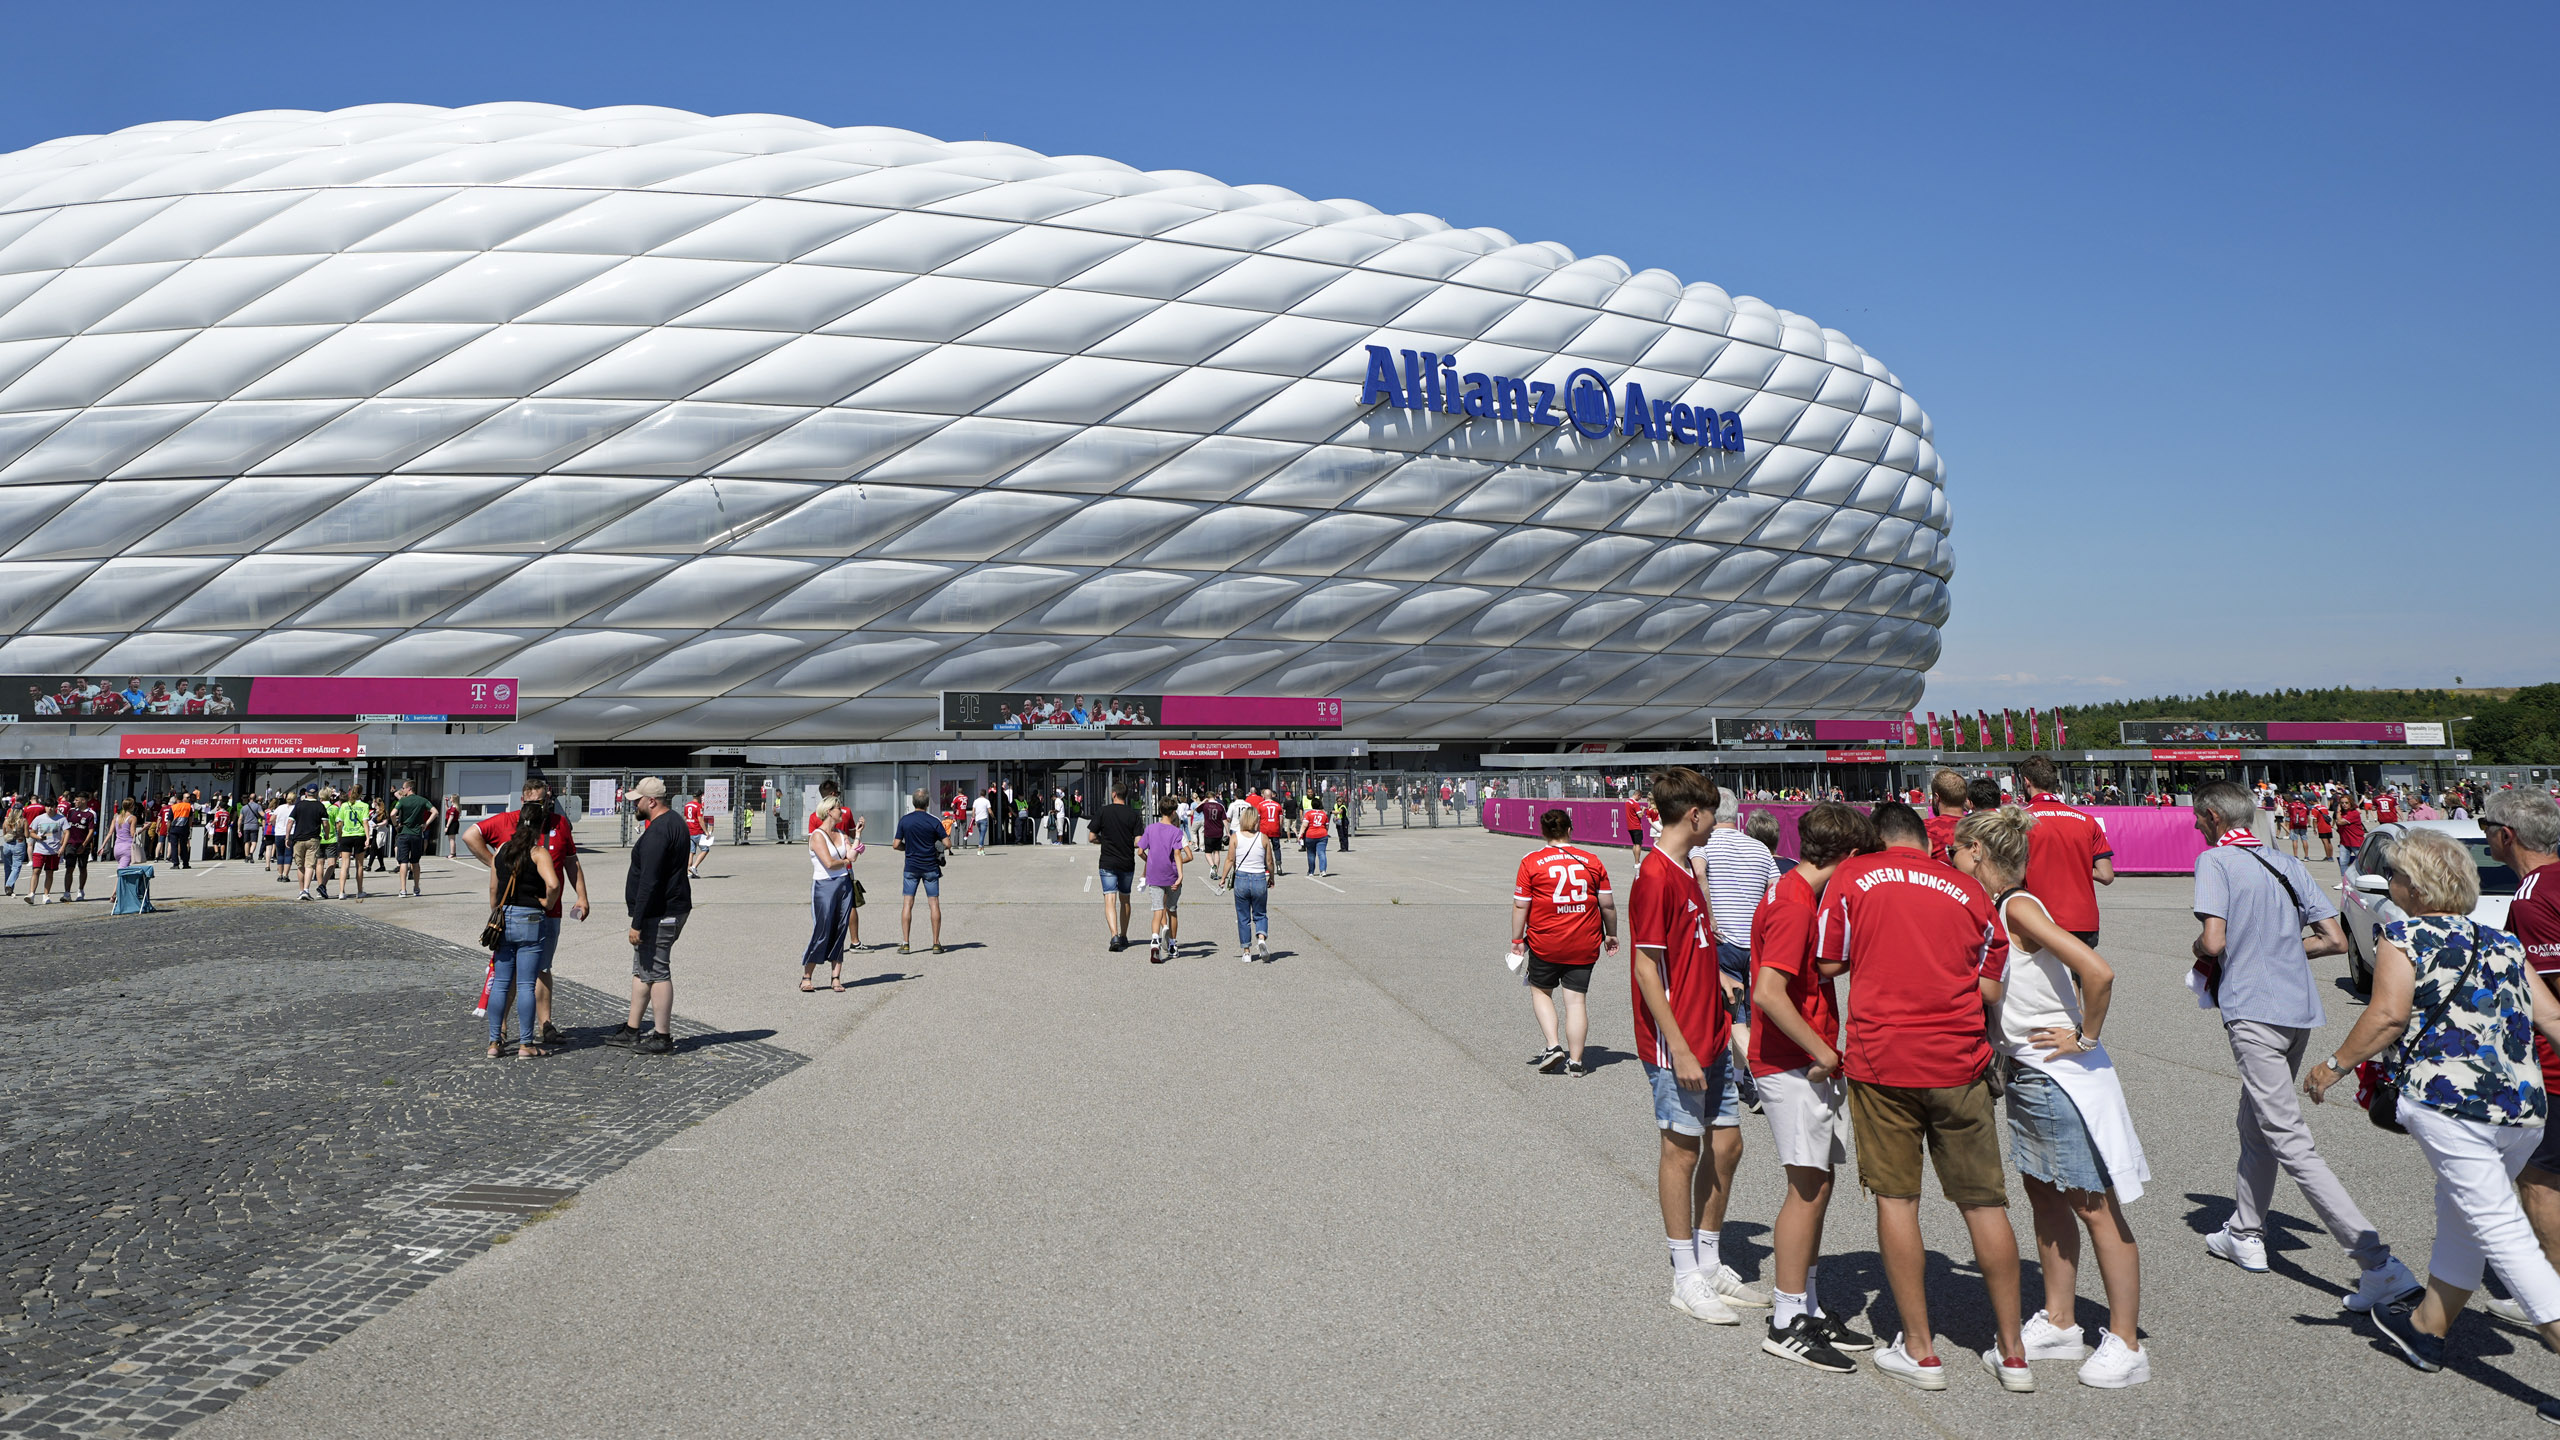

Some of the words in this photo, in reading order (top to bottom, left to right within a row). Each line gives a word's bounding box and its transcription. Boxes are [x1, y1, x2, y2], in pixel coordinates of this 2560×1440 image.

[1362, 344, 1560, 427] Allianz
[1623, 382, 1745, 452] Arena
[1266, 806, 1276, 818] 17
[2033, 810, 2056, 818] BAYERN
[1548, 864, 1588, 903] 25
[1855, 867, 1905, 893] BAYERN
[1908, 870, 1971, 905] MÜNCHEN
[1557, 904, 1586, 914] MÜLLER
